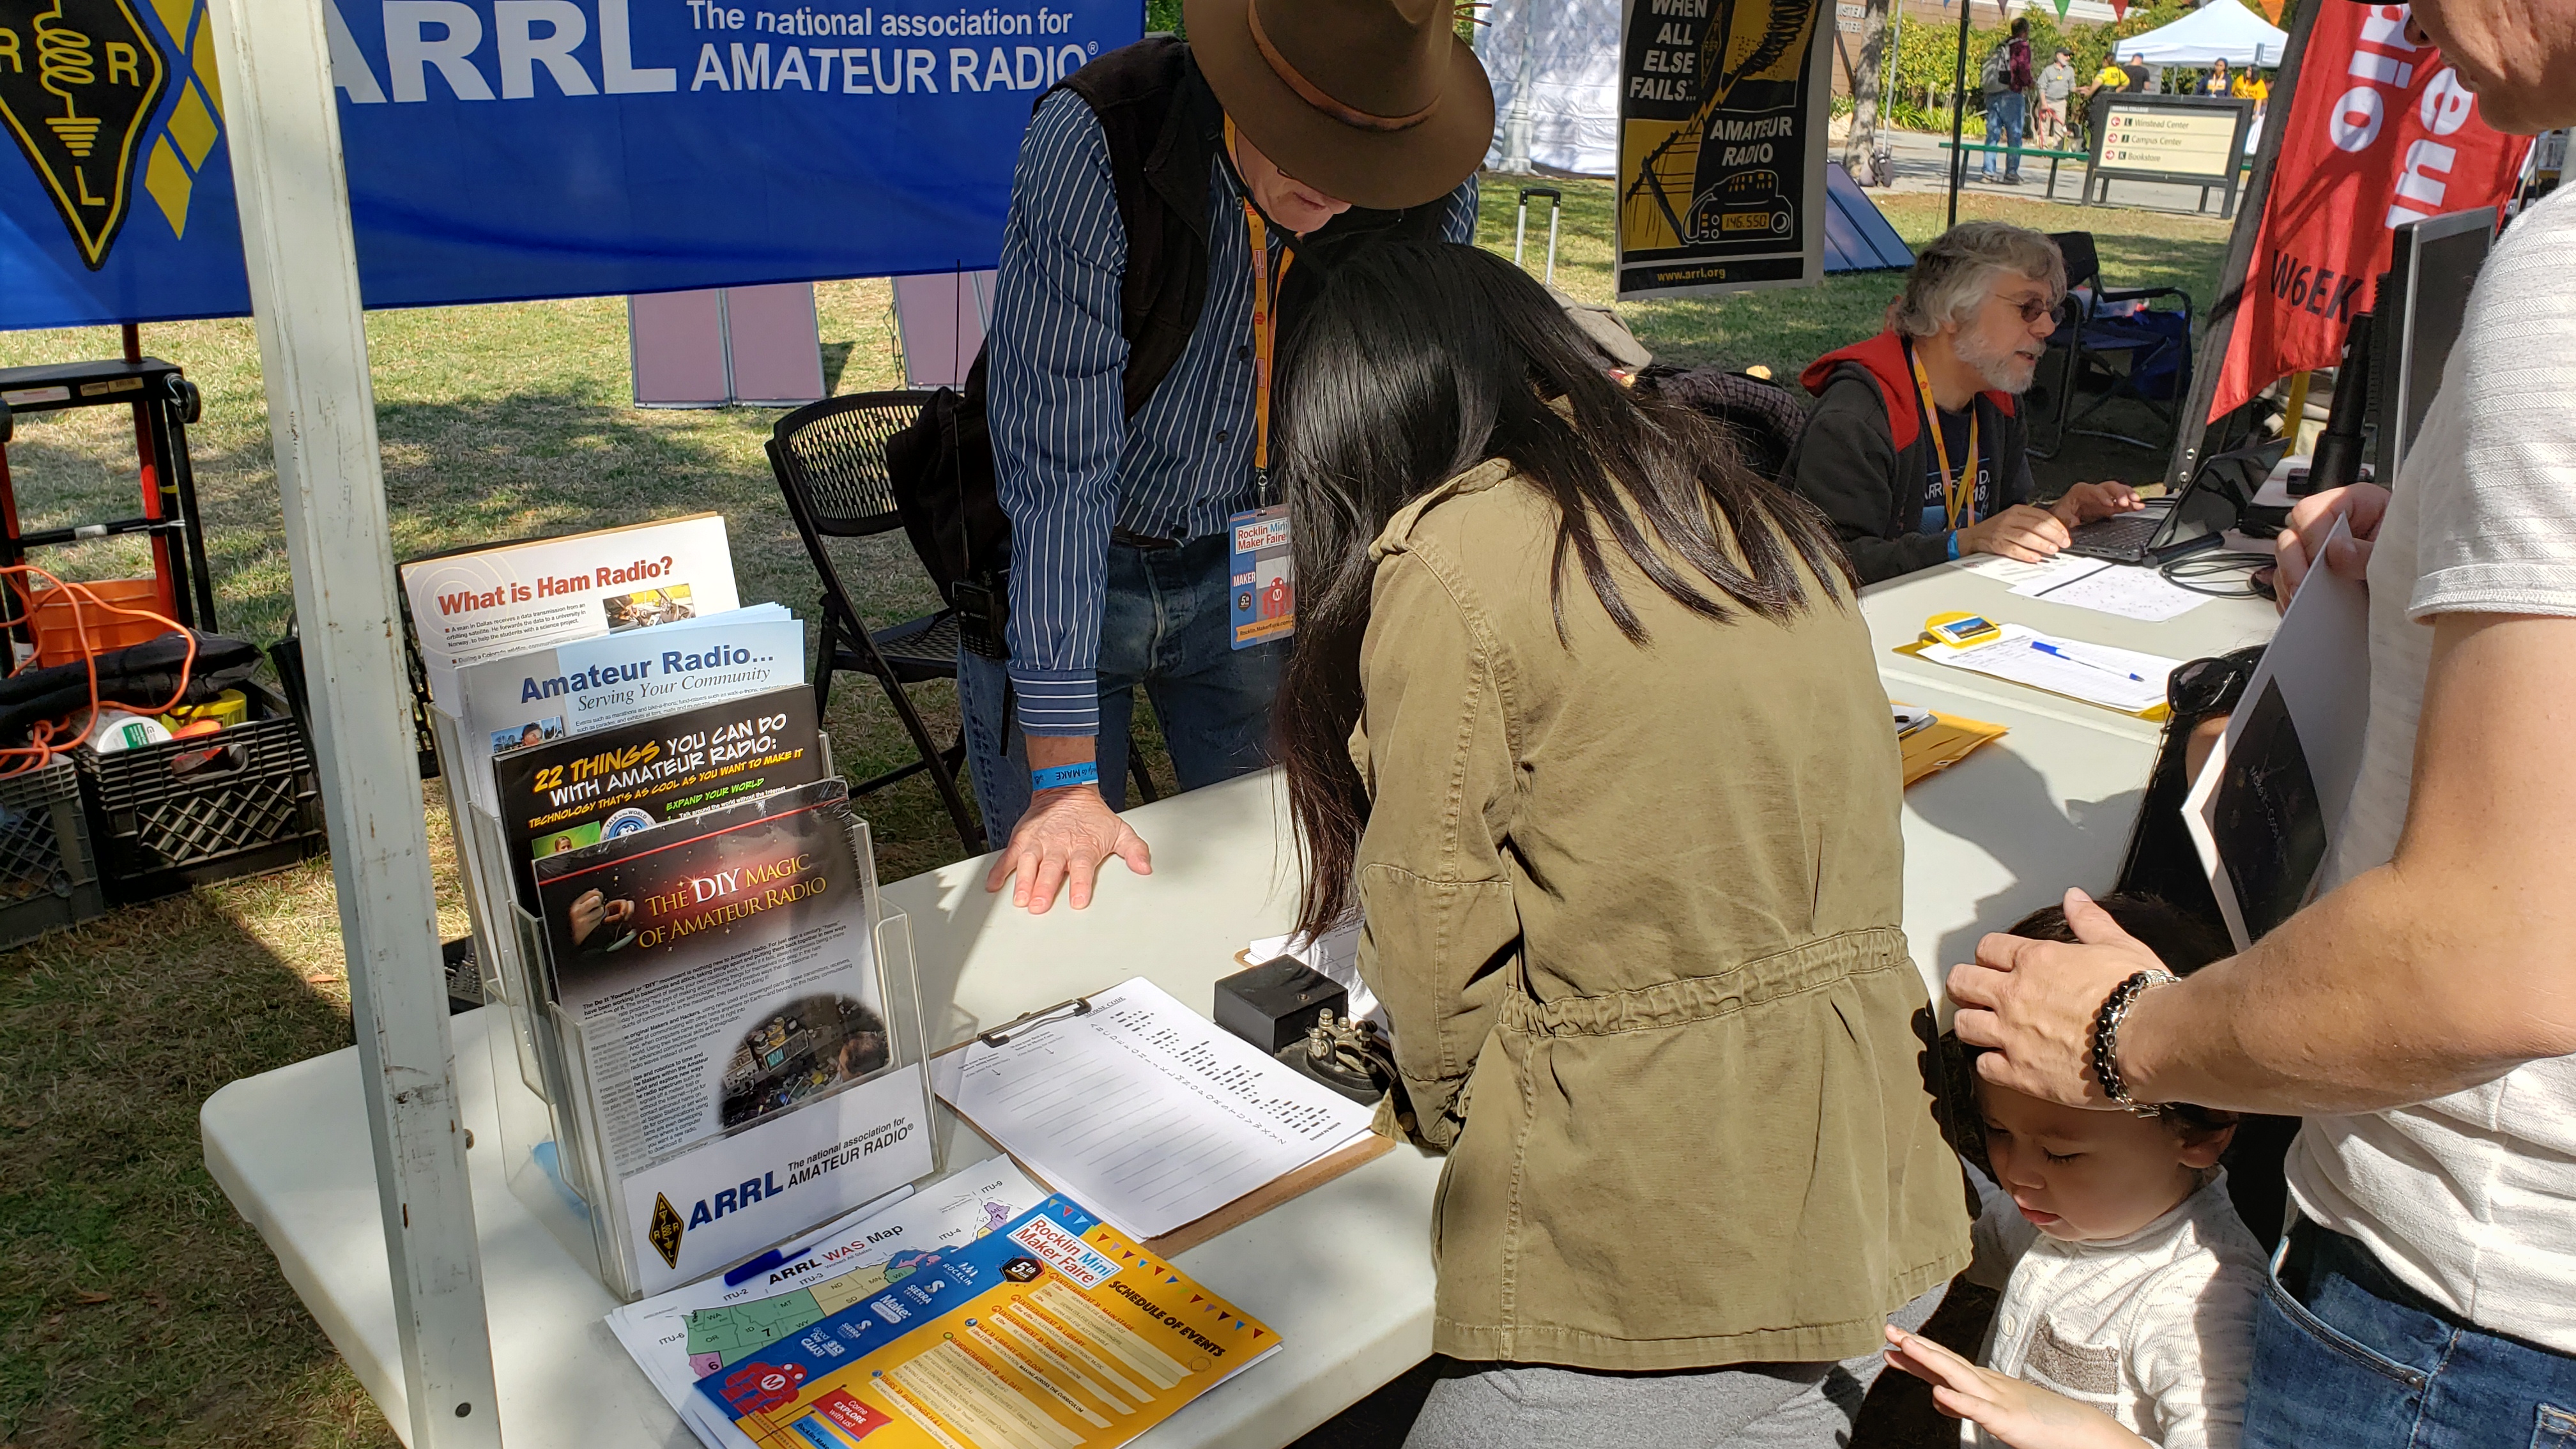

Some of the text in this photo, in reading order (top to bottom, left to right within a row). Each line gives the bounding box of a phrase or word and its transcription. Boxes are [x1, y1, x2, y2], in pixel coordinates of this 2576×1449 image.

[687, 0, 1072, 37] The national association for
[1651, 0, 1707, 18] WHEN
[1655, 22, 1694, 45] ALL
[690, 43, 937, 94] AMATEUR
[1643, 49, 1696, 74] ELSE
[1709, 116, 1793, 141] AMATEUR
[2135, 119, 2165, 128] Winstead
[2166, 120, 2189, 129] Center
[2132, 136, 2158, 144] Campus
[2160, 137, 2182, 145] Center
[1721, 142, 1774, 166] RADIO
[2128, 153, 2161, 162] Bookstore
[1724, 213, 1768, 229] 146.550
[1657, 266, 1726, 282] www.arrl.org
[2270, 249, 2363, 325] W6EK
[1238, 525, 1268, 540] Rocklin
[1238, 533, 1286, 551] Maker Faire
[438, 556, 673, 615] What is Ham Radio?
[1233, 572, 1256, 586] MAKER
[500, 622, 523, 631] forwards
[556, 611, 580, 620] university
[533, 607, 565, 618] transmission
[500, 629, 523, 638] students
[520, 645, 774, 704] Amateur Radio...
[578, 666, 770, 711] Serving Your Community
[533, 713, 787, 792] 22 THINGS YOU CAN DO
[549, 737, 778, 807] WITH AMATEUR RADIO:
[1056, 769, 1080, 780] MAKE
[528, 747, 804, 829] TECHNOLOGY THAT'S AS COOL AS YOU WANT TO MAKE IT
[666, 777, 765, 811] EXPAND YOUR WORLD
[679, 811, 691, 819] Talk
[692, 805, 711, 815] around
[721, 799, 735, 808] world
[736, 793, 755, 804] without
[765, 786, 786, 796] Internet
[628, 810, 647, 820] WORLD
[693, 868, 741, 905] DIY
[640, 877, 827, 949] OF AMATEUR RADIO
[788, 1116, 905, 1172] The national association for
[788, 1148, 860, 1188] AMATEUR
[981, 1181, 1002, 1193] ITU-9
[688, 1170, 784, 1232] ARRL
[654, 1222, 679, 1239] R R
[939, 1228, 962, 1240] ITU-4
[768, 1224, 903, 1285] ARRL WAS Map
[1016, 1227, 1094, 1284] Maker Faire
[1030, 1219, 1115, 1276] Rocklin Mini
[942, 1263, 973, 1286] ROCKLIN
[1012, 1262, 1036, 1273] 5th
[799, 1273, 824, 1285] ITU-3
[831, 1282, 843, 1290] ND
[868, 1276, 882, 1284] MN
[723, 1288, 748, 1301] ITU-2
[779, 1300, 793, 1308] MT
[907, 1284, 932, 1305] SIERRA
[1056, 1278, 1135, 1331] ENTERTAINMENT STAGE
[707, 1312, 722, 1321] WA
[795, 1319, 809, 1328] WY
[1018, 1300, 1086, 1347] ENTERTAINMENT LIBRARY
[1108, 1280, 1225, 1357] SCHEDULE OF EVENTS
[659, 1332, 685, 1345] ITU-6
[705, 1335, 719, 1343] OR
[762, 1327, 770, 1337] 7
[841, 1322, 861, 1338] SIERRA
[999, 1310, 1068, 1360] ENTERTAINMENT THEATRE
[977, 1323, 1044, 1373] TALK LIBRARY FLOOR
[708, 1361, 719, 1370] 6
[950, 1337, 993, 1370] DEMONSTRATIONS
[999, 1375, 1009, 1383] ALL
[880, 1376, 929, 1417] TOURS BUILDINGS
[834, 1401, 866, 1424] EXPLORE
[848, 1400, 868, 1415] Come
[829, 1410, 856, 1428] with us!
